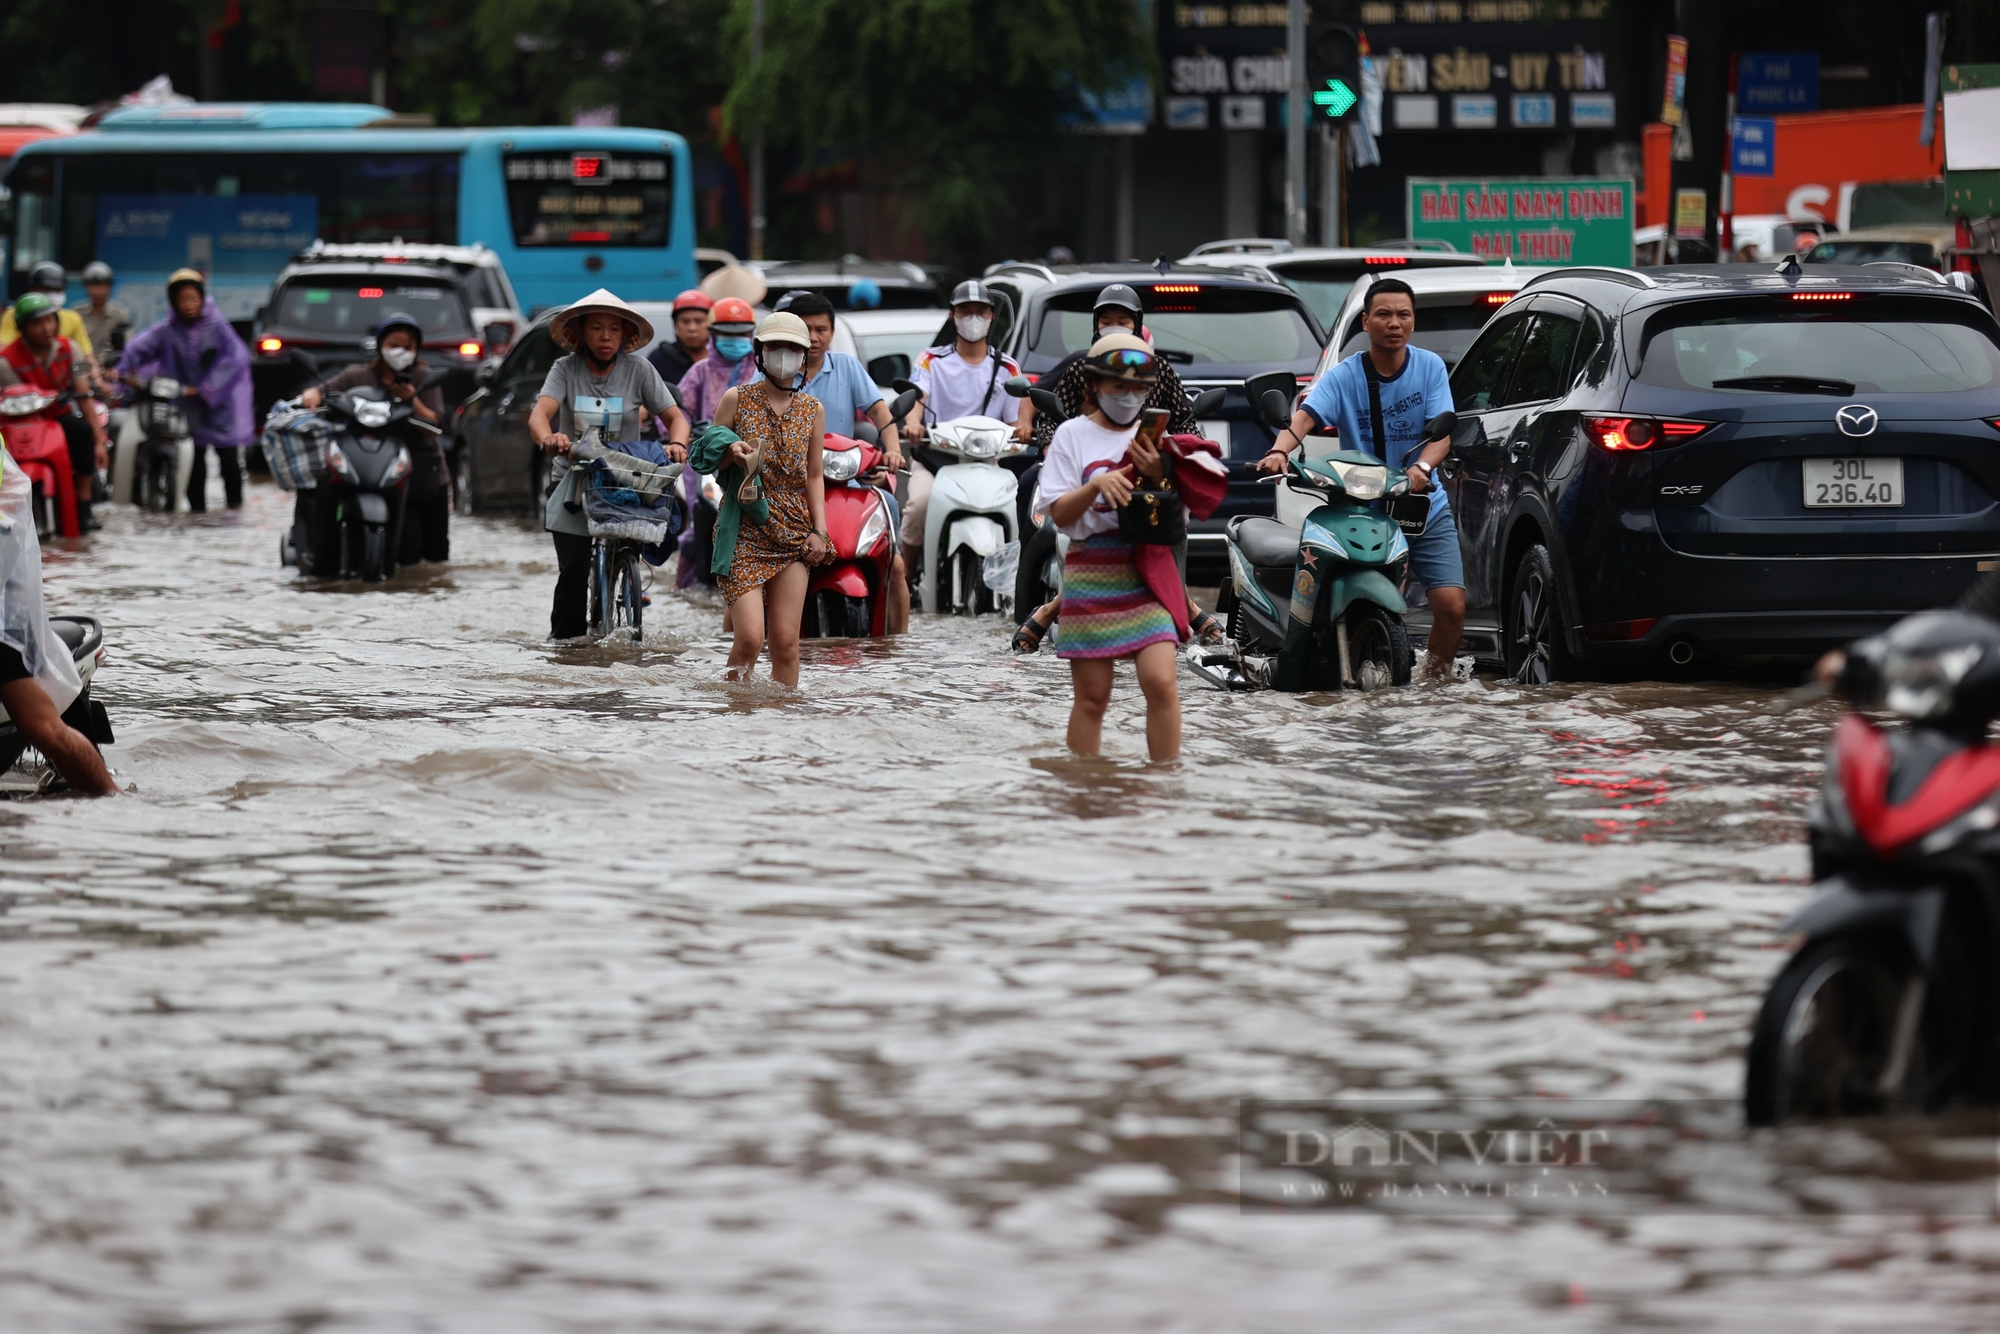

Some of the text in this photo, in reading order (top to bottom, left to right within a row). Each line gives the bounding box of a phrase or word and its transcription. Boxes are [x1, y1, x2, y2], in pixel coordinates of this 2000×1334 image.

[1510, 53, 1549, 91] UY
[1421, 181, 1623, 225] HẢI SẢN NAM ĐỊNH
[1833, 460, 1874, 480] 30L
[1660, 485, 1703, 496] CX-5
[1816, 483, 1892, 504] 236.40
